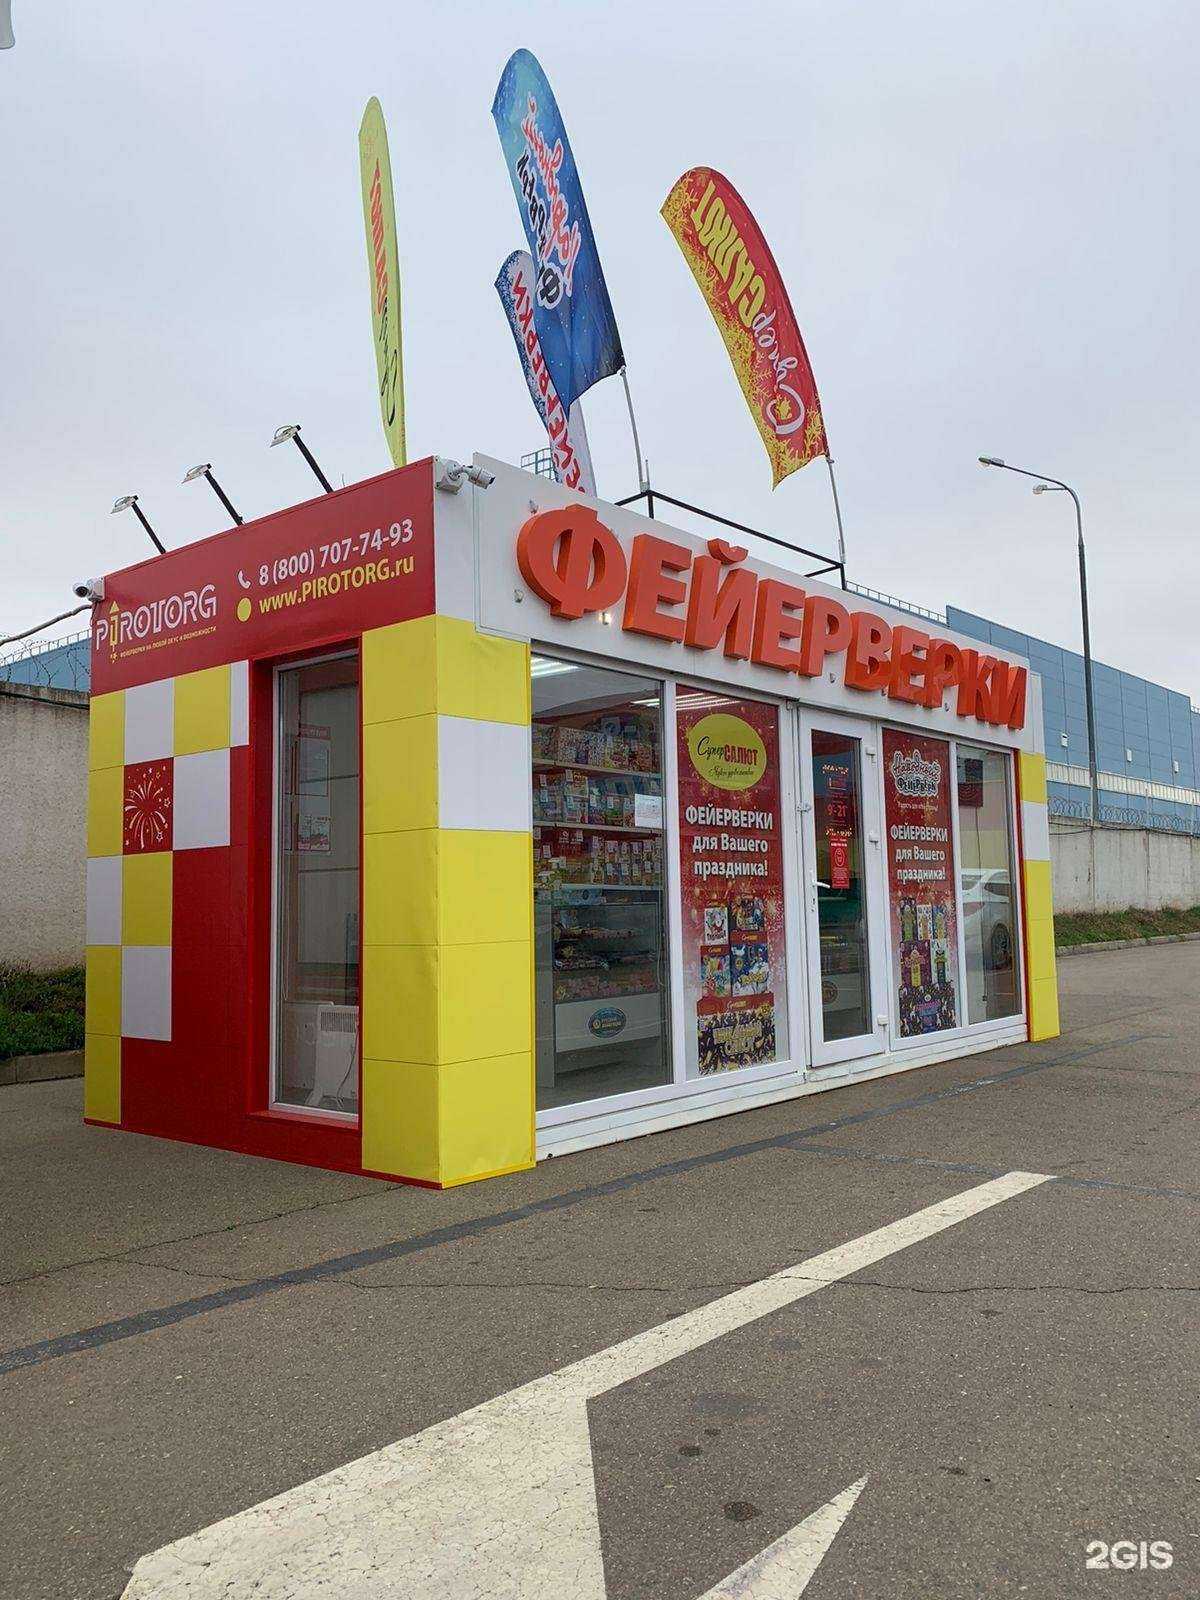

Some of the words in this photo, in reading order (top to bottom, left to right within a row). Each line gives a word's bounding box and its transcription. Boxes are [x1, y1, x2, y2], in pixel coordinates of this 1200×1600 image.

[513, 271, 586, 493] ЕЙЕРВЕРКИ
[259, 564, 269, 586] 8
[273, 549, 315, 584] (800)
[319, 518, 413, 568] 707-74-93
[258, 556, 415, 614] www.PIROTORG.ru
[96, 584, 217, 652] PIROTORG
[516, 503, 1027, 730] ФЕЙЕРВЕРКИ
[685, 803, 773, 830] ФЕЙЕРВЕРКИ
[693, 836, 718, 853] для
[721, 833, 768, 853] Вашего
[890, 822, 948, 842] ФЕЙЕРВЕРКИ
[896, 849, 912, 862] для
[913, 845, 946, 861] Вашего
[694, 860, 768, 881] праздника!
[897, 866, 946, 885] праздника!
